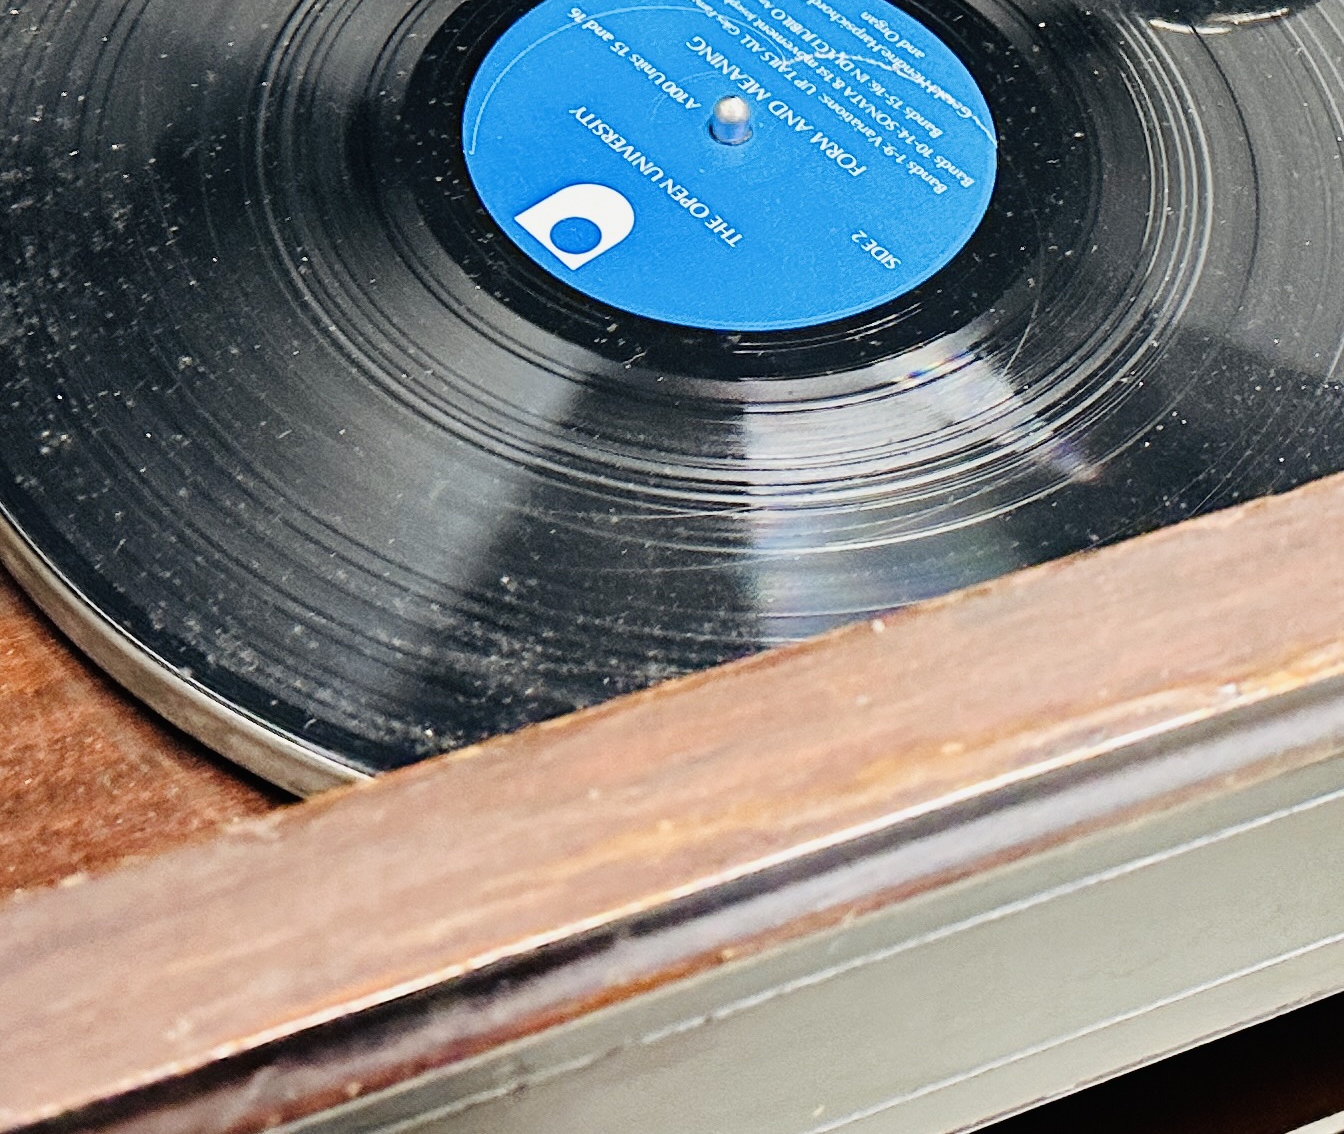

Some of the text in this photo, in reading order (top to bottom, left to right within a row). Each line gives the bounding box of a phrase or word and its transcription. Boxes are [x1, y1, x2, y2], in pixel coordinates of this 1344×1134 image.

[771, 8, 817, 42] JUBILO
[860, 11, 925, 58] and Organ
[567, 7, 701, 110] A100 Units 15 and 16
[740, 34, 766, 52] ALL
[753, 18, 818, 68] movement
[760, 52, 797, 81] TAILS
[816, 66, 834, 83] 1st
[832, 76, 845, 89] &
[850, 69, 870, 83] IN
[794, 79, 816, 95] UP
[686, 36, 867, 176] FORM AND MEANING
[843, 86, 900, 131] SONATA
[903, 107, 943, 138] Bands
[569, 106, 743, 247] THE OPEN UNIVERSITY
[907, 161, 947, 194] Bands
[934, 155, 974, 188] Bands
[852, 230, 901, 269] SIDE 2
